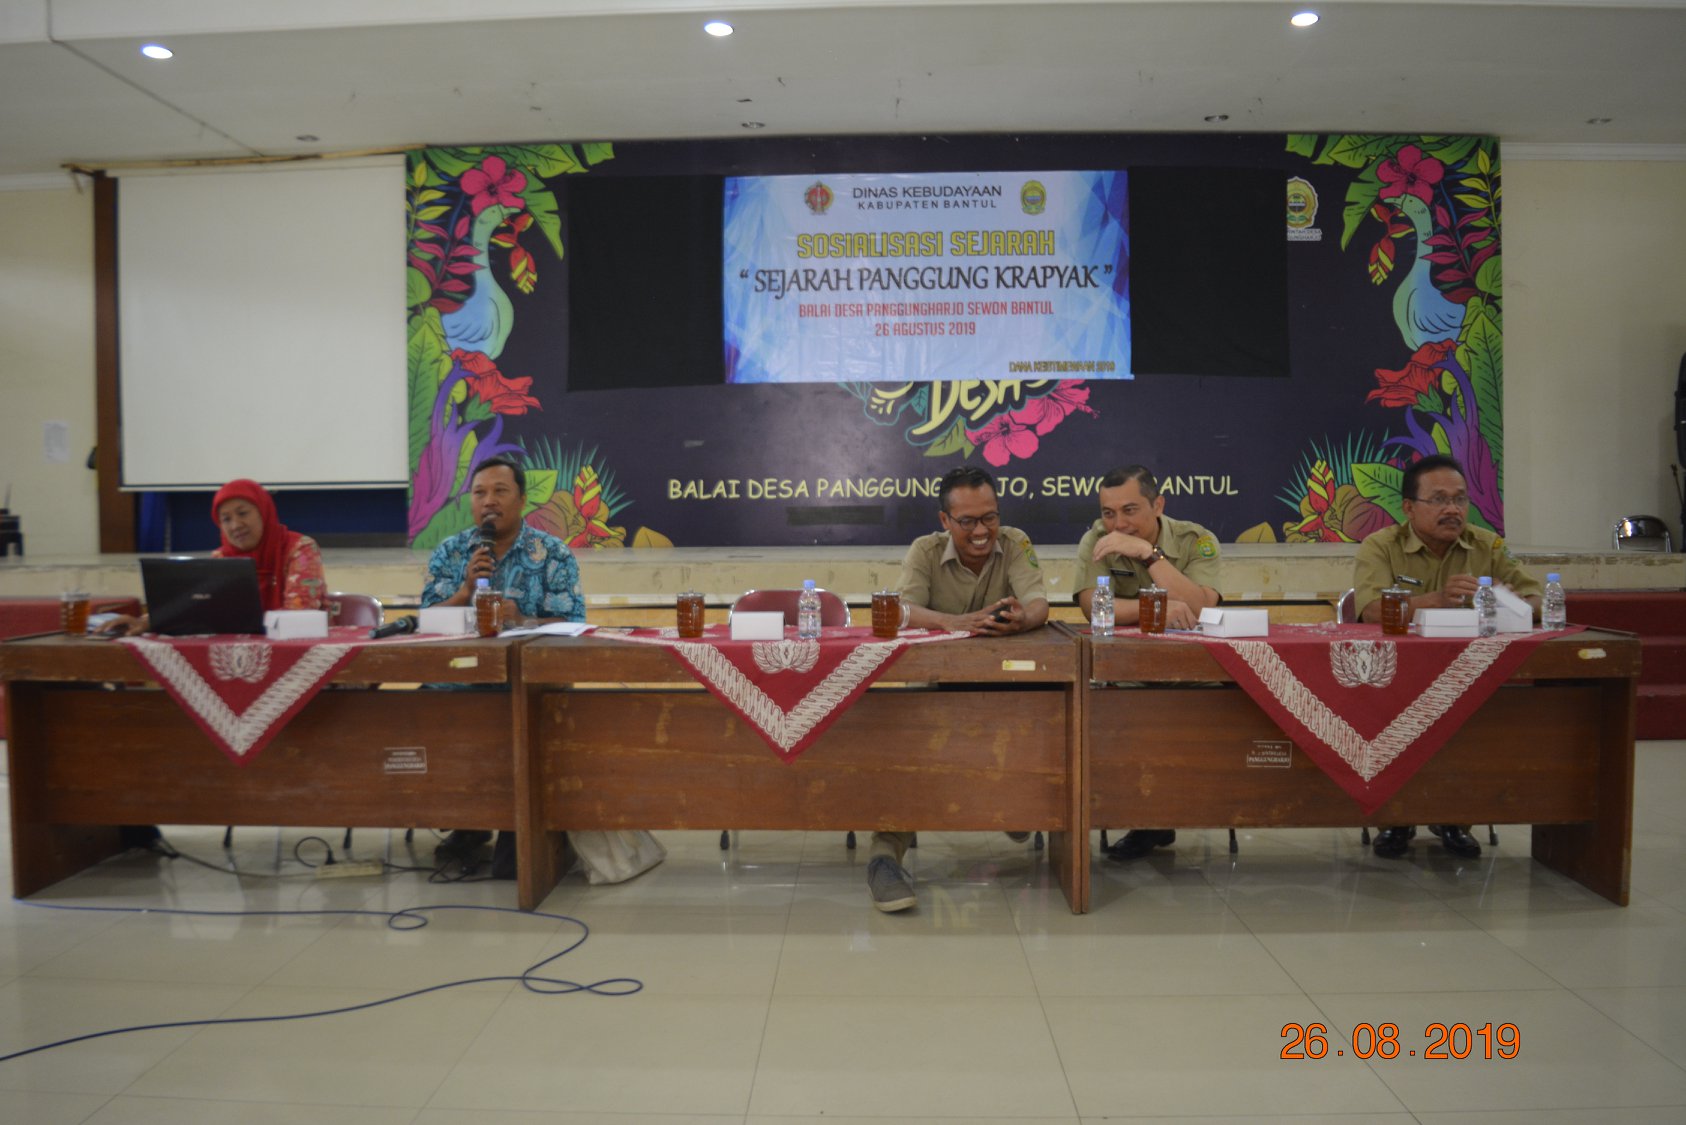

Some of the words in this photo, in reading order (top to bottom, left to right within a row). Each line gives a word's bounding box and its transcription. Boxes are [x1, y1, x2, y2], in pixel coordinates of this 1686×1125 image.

[852, 187, 898, 199] DINAS
[902, 185, 1002, 198] KEBUDAYAAN
[858, 201, 939, 210] KABUPATEN
[943, 199, 997, 209] BANTUL
[797, 231, 944, 258] SOSIALISASI
[950, 230, 1056, 256] SEJARAH
[754, 268, 853, 300] SEJARAH
[857, 265, 989, 291] PANGGUNG
[994, 264, 1099, 289] KRAPYAK
[799, 303, 831, 317] BALAI
[835, 303, 863, 317] DESA
[866, 302, 964, 316] PANGGUNGHARJO
[967, 301, 1008, 316] SEWON
[1011, 301, 1054, 315] BANTUL
[874, 323, 890, 337] 26
[893, 322, 945, 336] AGUSTUS
[948, 321, 976, 335] 2019
[668, 479, 741, 499] BALAI
[747, 478, 810, 499] DESA
[1153, 475, 1239, 496] ANTUL
